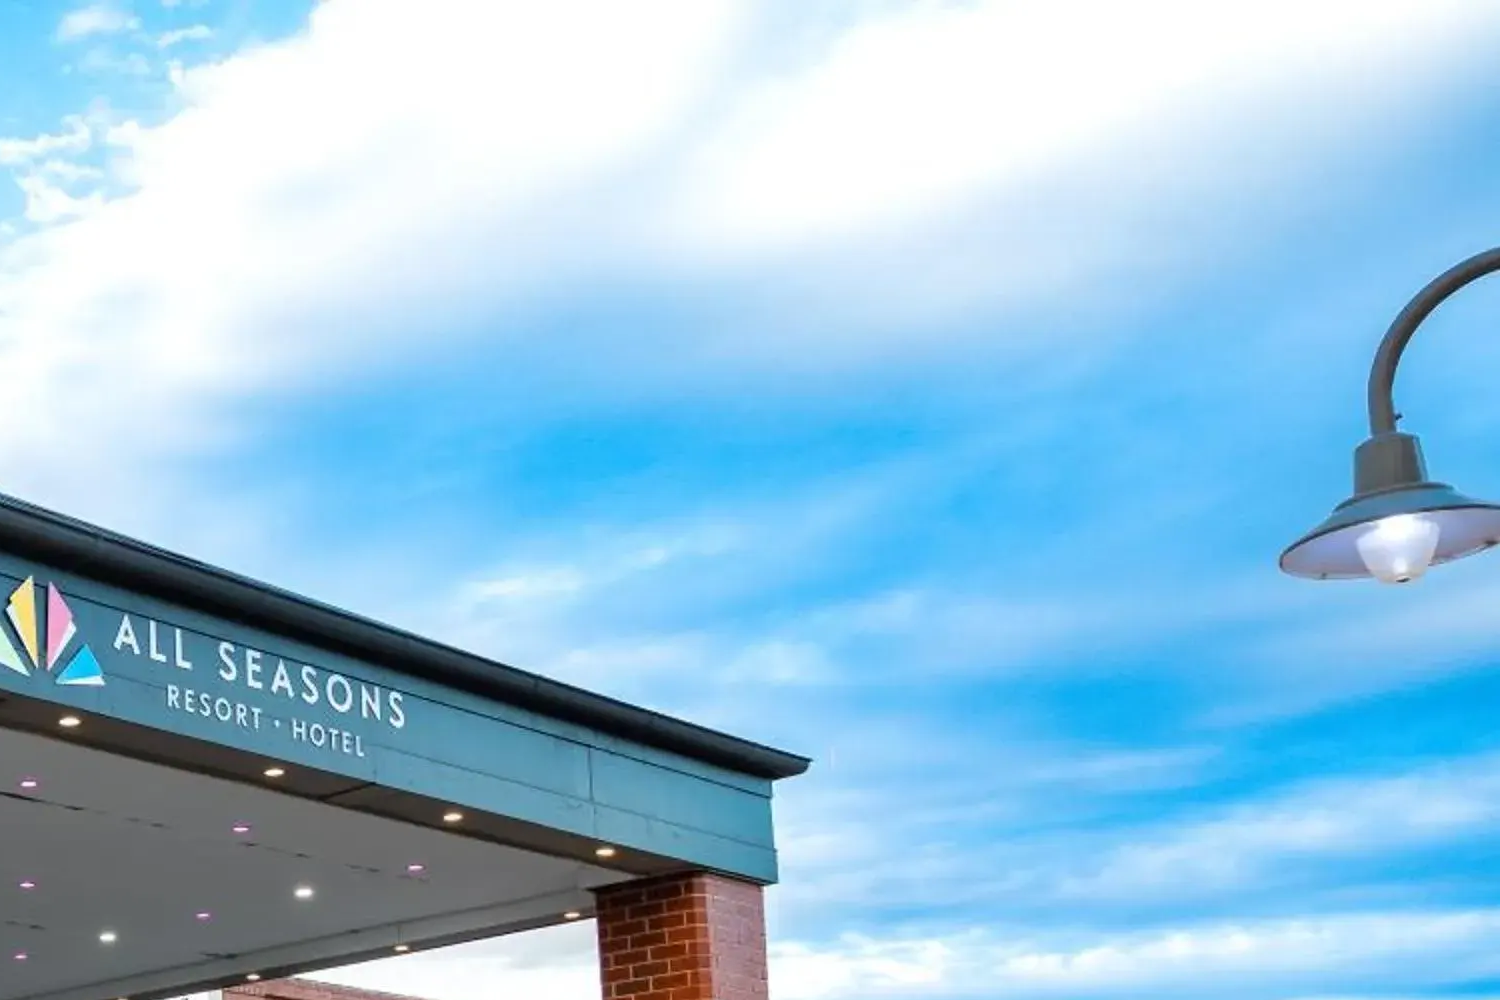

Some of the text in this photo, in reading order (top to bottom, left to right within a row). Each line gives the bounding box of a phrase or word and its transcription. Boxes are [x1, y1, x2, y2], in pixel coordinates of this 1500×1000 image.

[113, 614, 406, 729] ALL SEASONS
[167, 684, 365, 757] RESORT HOTEL
